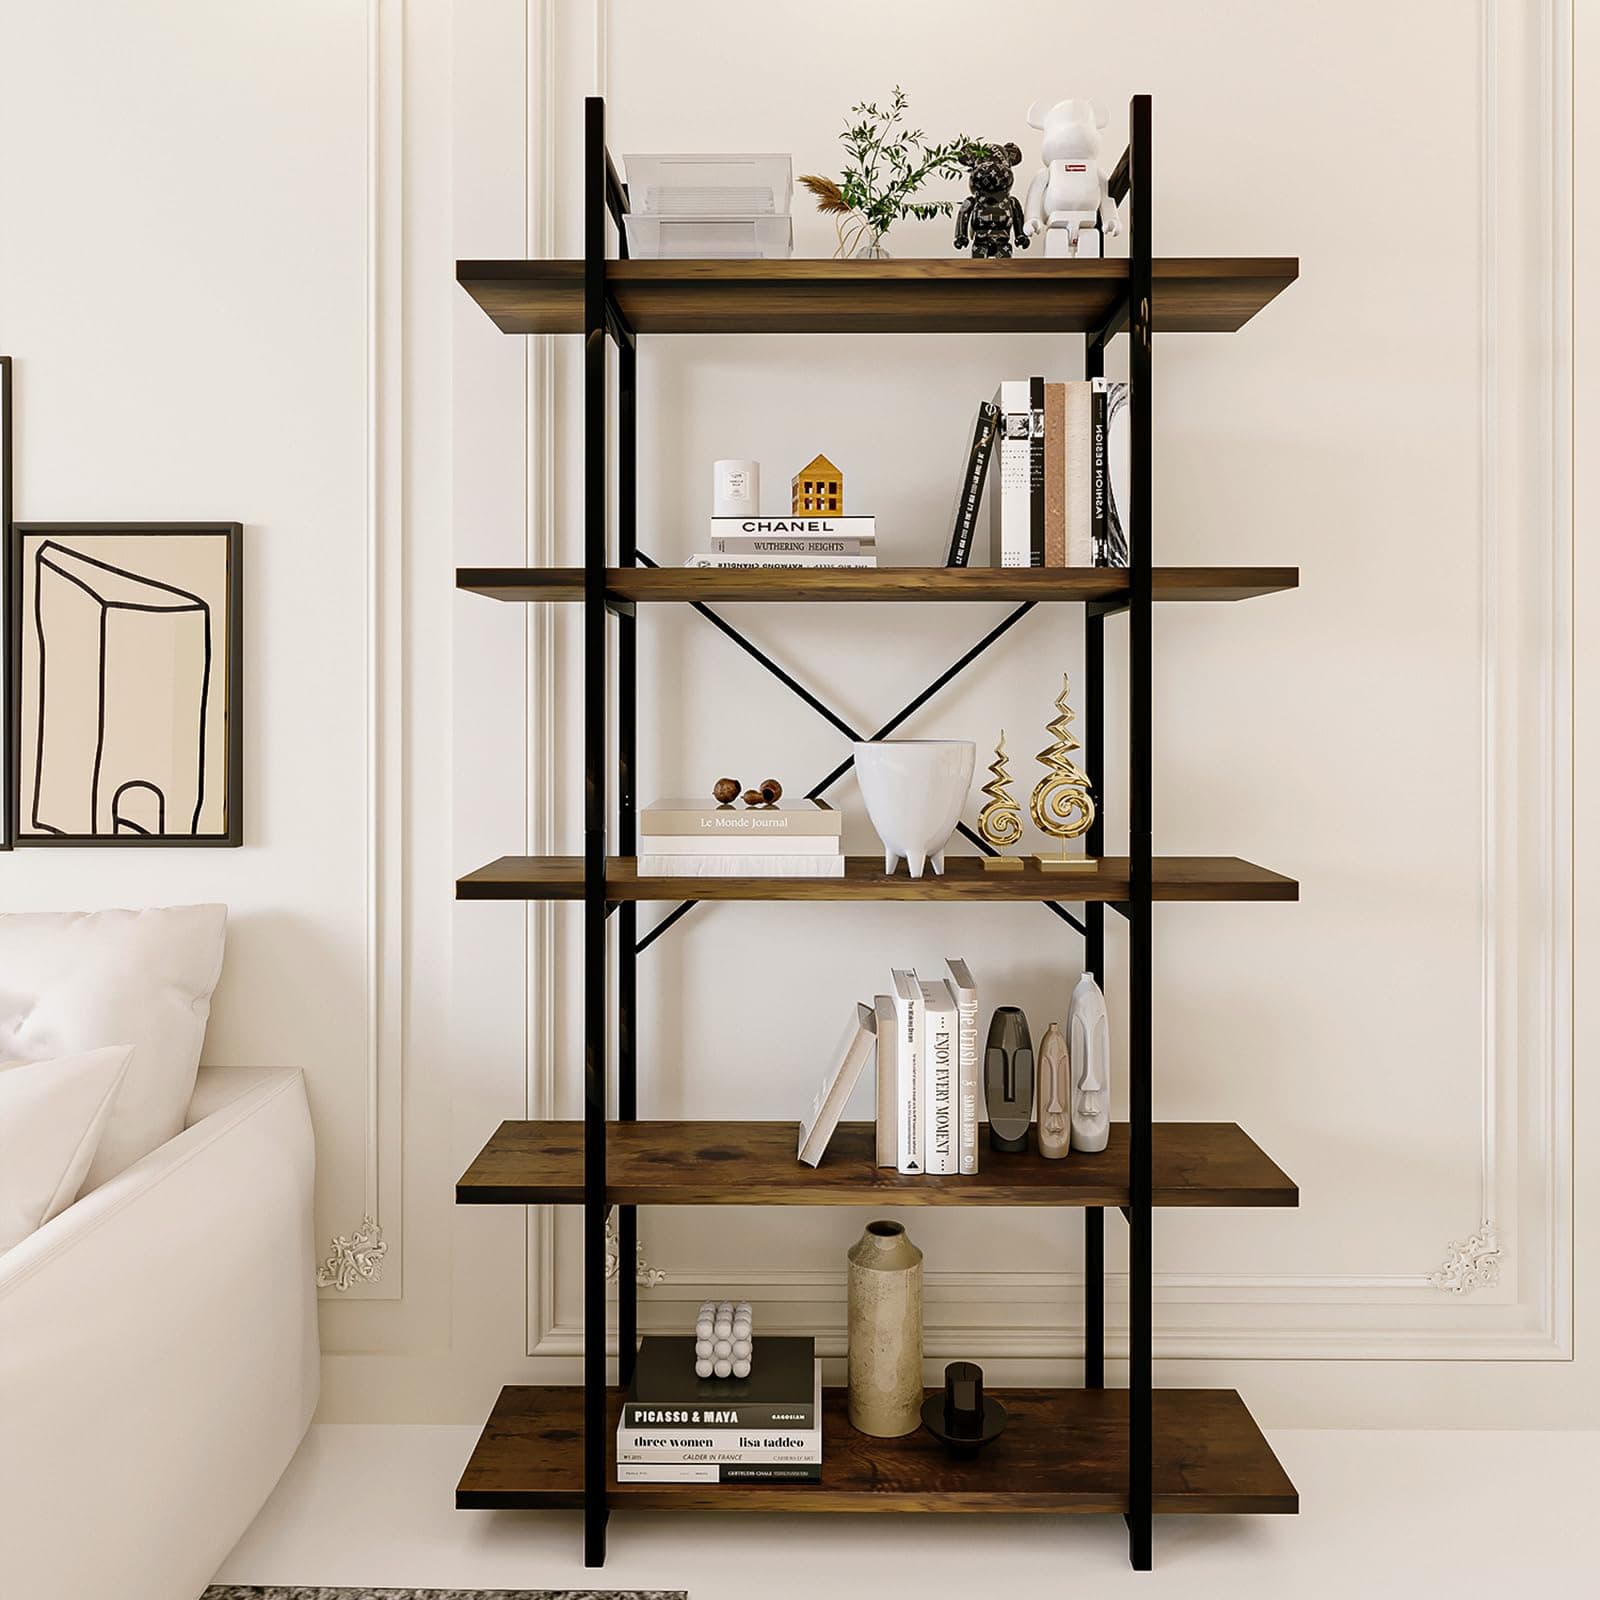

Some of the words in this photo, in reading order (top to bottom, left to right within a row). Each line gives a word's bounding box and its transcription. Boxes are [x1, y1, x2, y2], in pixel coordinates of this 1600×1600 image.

[742, 521, 834, 532] CHANEL
[753, 542, 805, 551] WUTHERING
[808, 542, 845, 551] HEIGHTS
[701, 817, 713, 828] Le
[715, 817, 750, 828] Monde
[752, 817, 788, 828] Journal
[960, 1000, 978, 1026] The
[934, 1032, 950, 1067] ENJOY
[960, 1029, 978, 1066] Crush
[935, 1069, 950, 1104] EVERY
[935, 1106, 950, 1156] MOMENT
[634, 1410, 689, 1423] PICASSO
[691, 1410, 701, 1423] &
[703, 1410, 739, 1423] MAYA
[634, 1436, 667, 1448] three
[669, 1439, 714, 1448] women
[739, 1436, 761, 1448] lisa
[763, 1436, 804, 1448] taddeo
